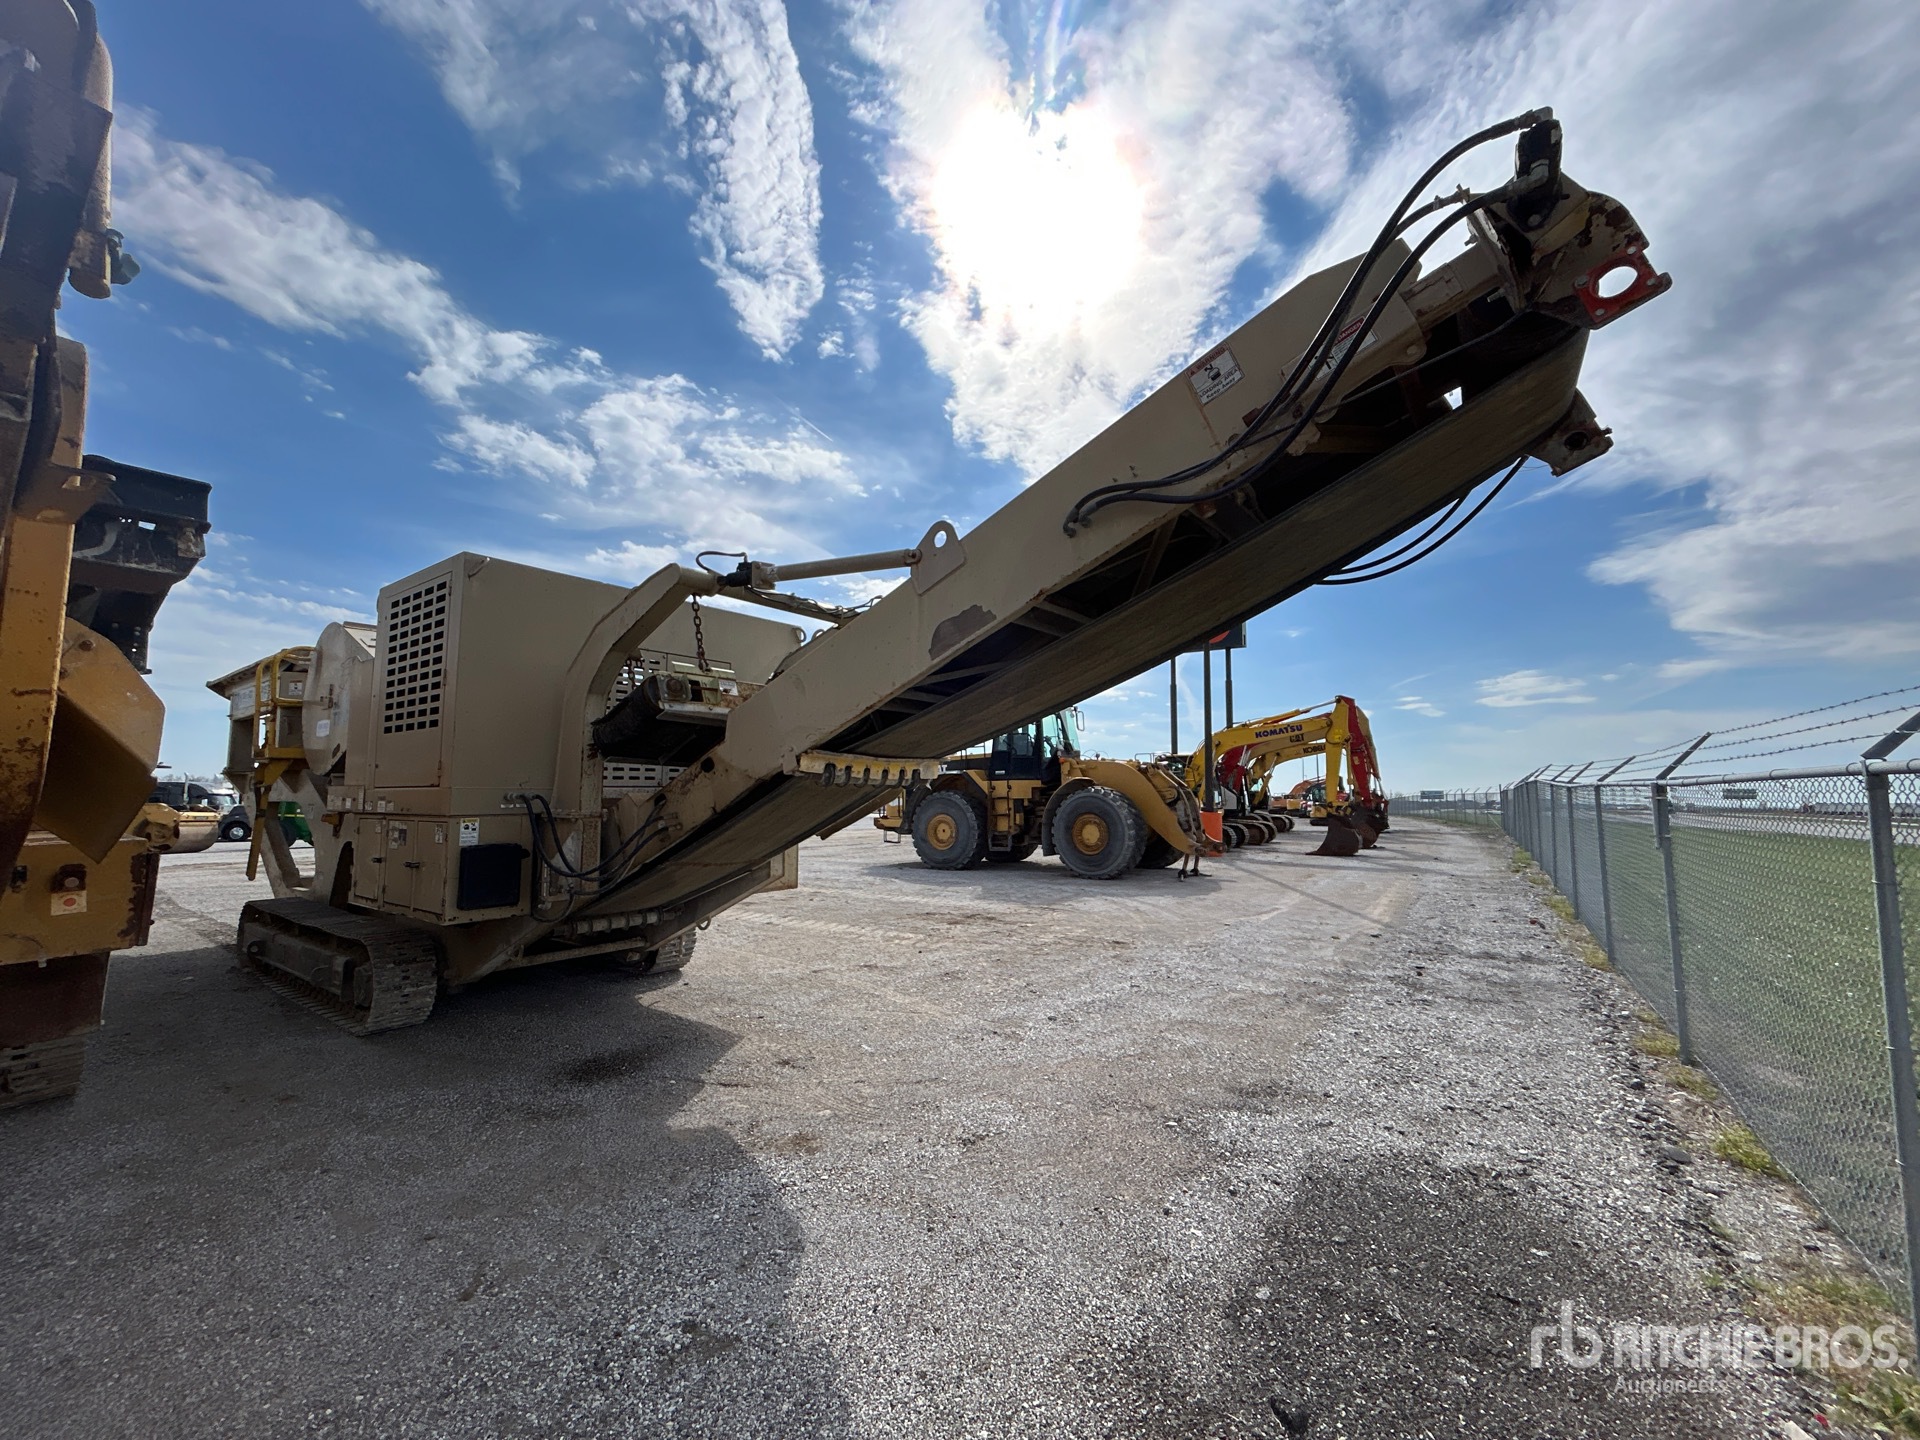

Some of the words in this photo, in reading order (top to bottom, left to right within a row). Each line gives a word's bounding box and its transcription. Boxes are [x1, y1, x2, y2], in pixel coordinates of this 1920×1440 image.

[1338, 321, 1362, 341] DANGER
[1196, 346, 1226, 371] WARNING
[1200, 380, 1223, 398] LOADING
[1223, 368, 1238, 381] AREA
[1206, 388, 1221, 399] Keep
[1221, 377, 1236, 389] Away
[1254, 724, 1303, 738] KOMATSU
[1289, 733, 1305, 743] CAT
[1302, 744, 1326, 754] KOBEL
